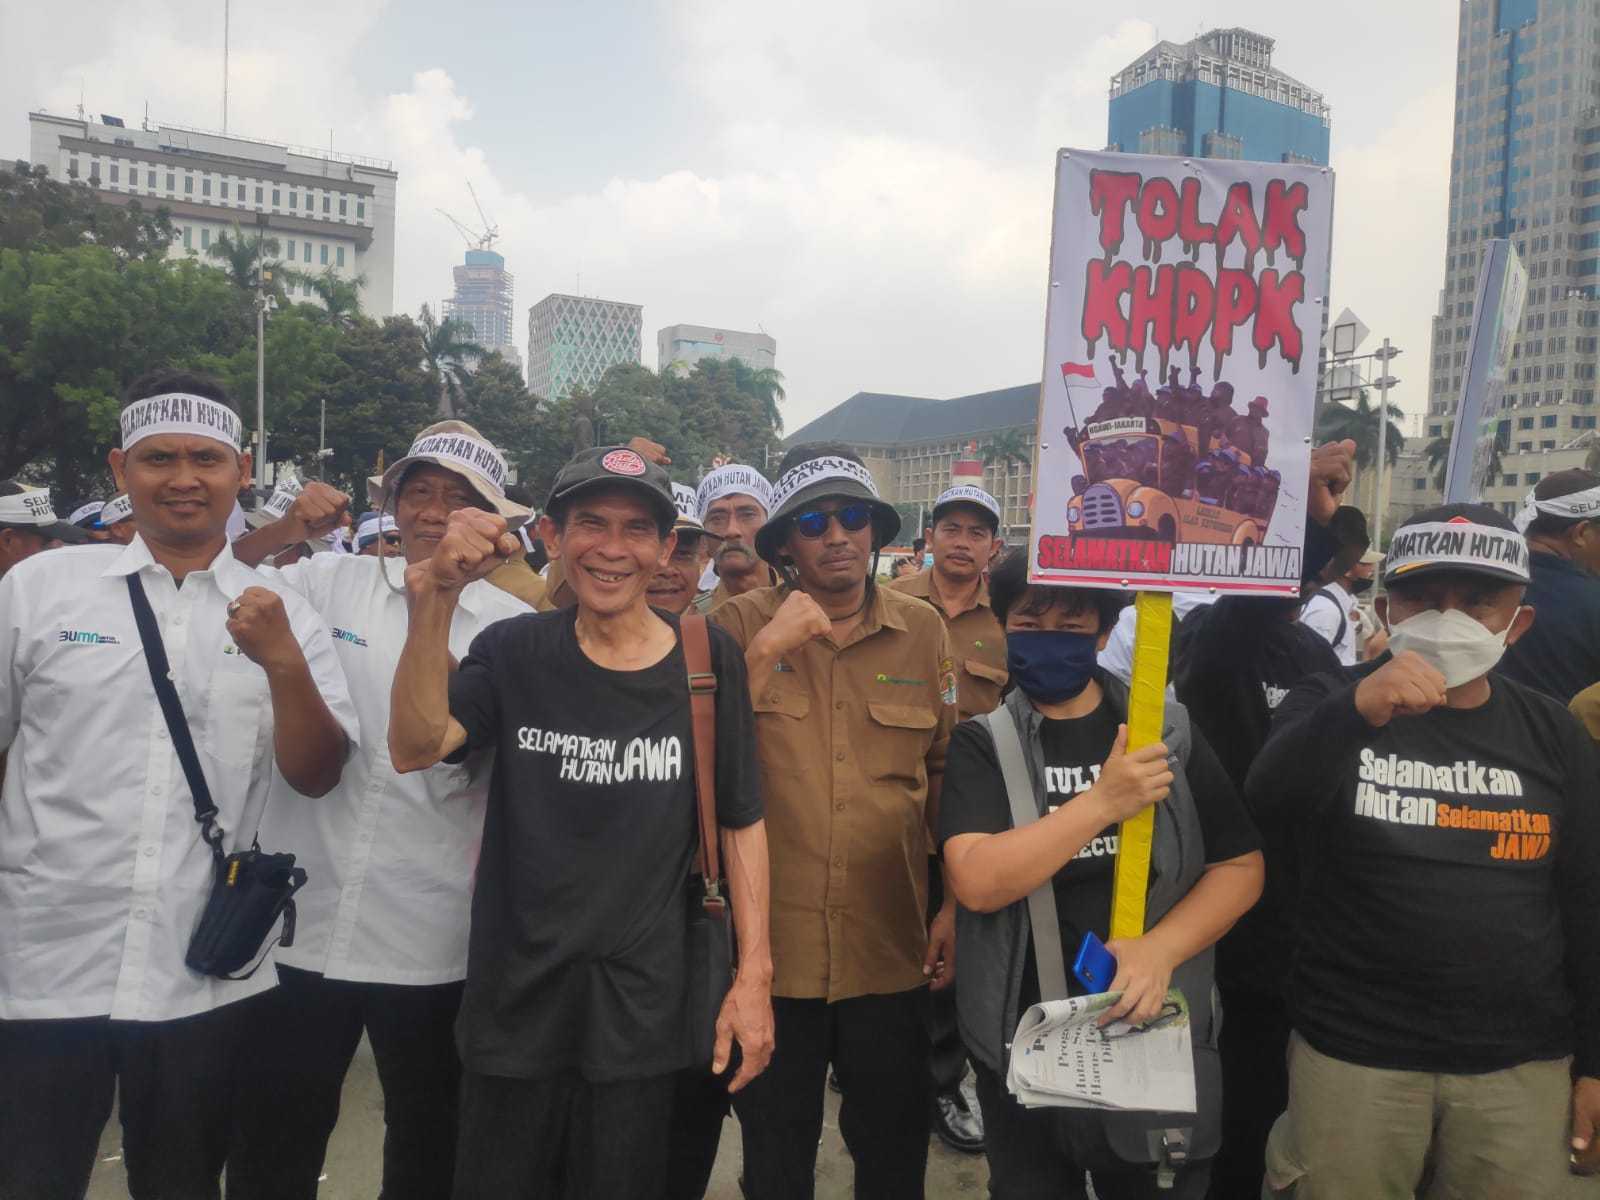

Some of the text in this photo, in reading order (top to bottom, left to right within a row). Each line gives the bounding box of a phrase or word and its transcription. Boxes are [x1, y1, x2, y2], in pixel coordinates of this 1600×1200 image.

[1089, 168, 1308, 266] TOLAK
[1081, 258, 1305, 374] KHDPK
[197, 401, 233, 440] HUTAN
[724, 471, 752, 487] HUTAN
[1038, 535, 1301, 580] SELAMATKAN HUTAN JAWA
[1470, 533, 1520, 566] HUTAN
[517, 726, 617, 762] SELAMATKAN
[560, 735, 682, 785] HUTAN JAWA
[1359, 747, 1523, 797] Selamatkan
[1354, 782, 1437, 826] Hutan
